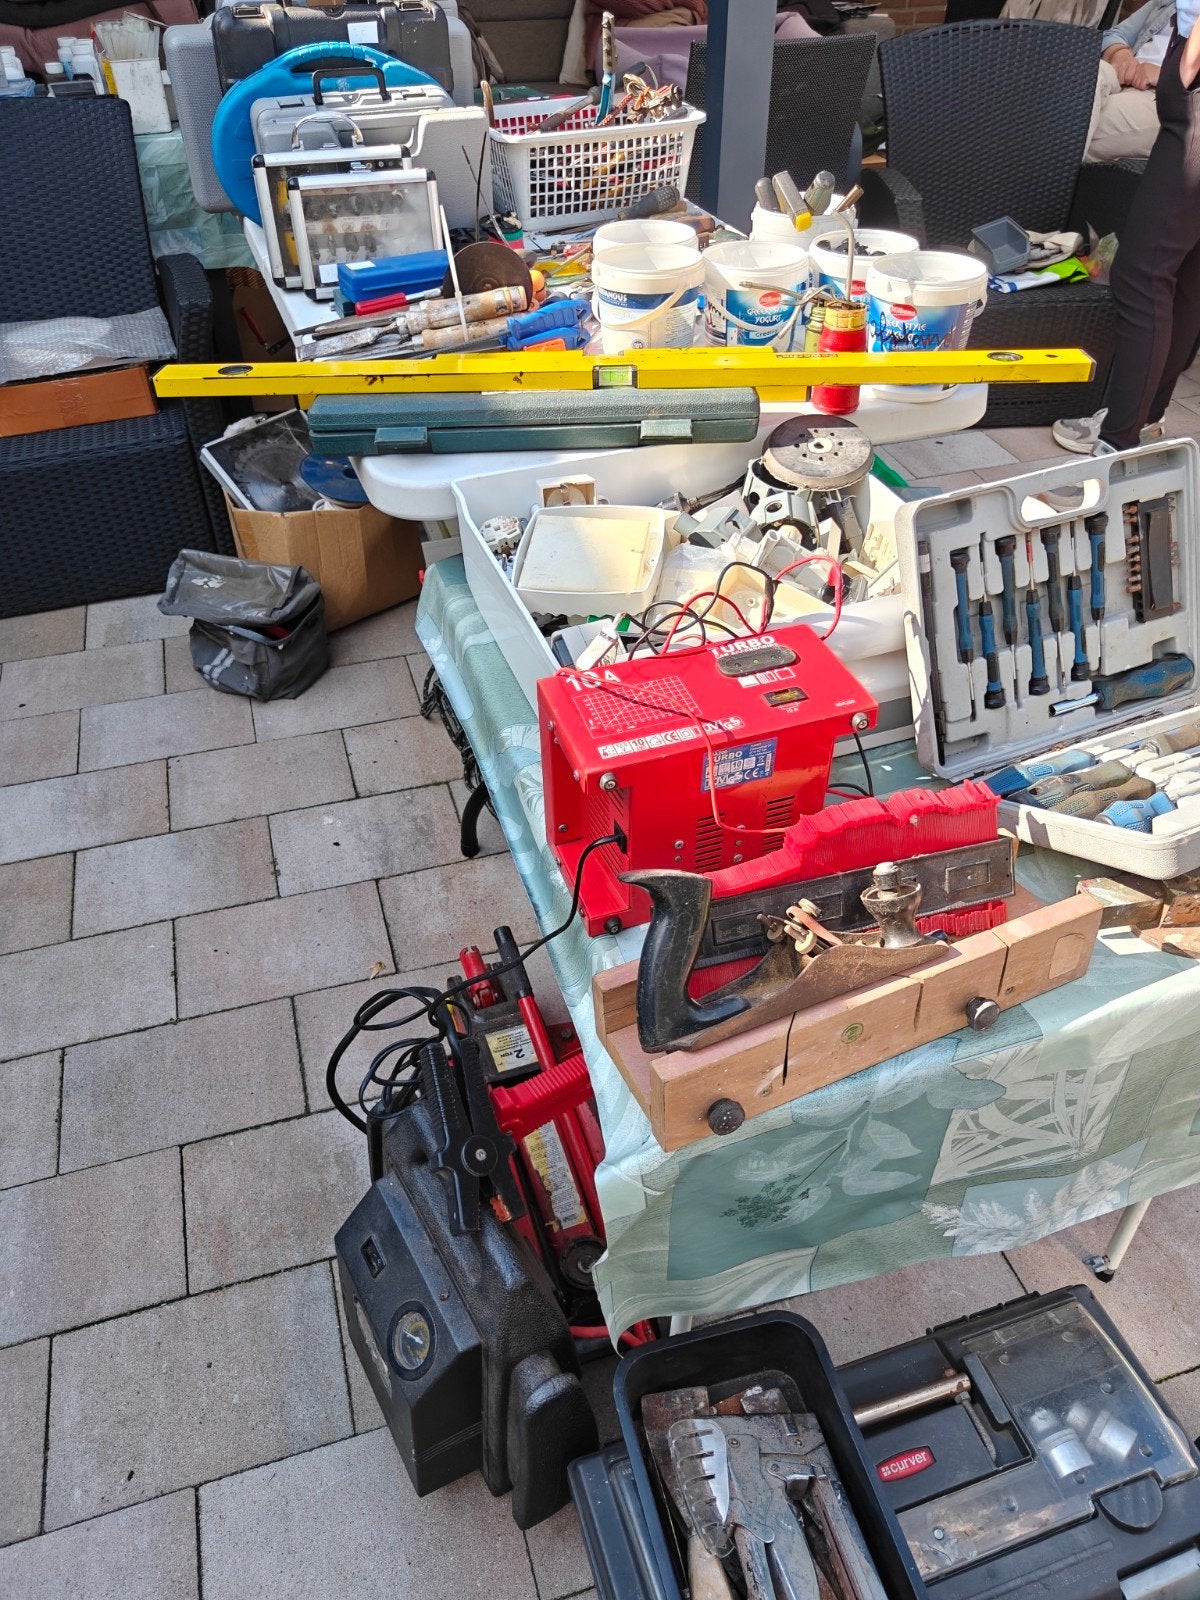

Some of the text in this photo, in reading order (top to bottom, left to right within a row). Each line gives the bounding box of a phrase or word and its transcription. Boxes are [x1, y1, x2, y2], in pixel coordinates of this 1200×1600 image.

[754, 315, 782, 324] YOGURT
[904, 322, 927, 331] STYLE
[708, 635, 776, 656] TURBO
[710, 750, 743, 762] URBO
[514, 1048, 526, 1058] 2
[889, 1452, 928, 1473] curver
